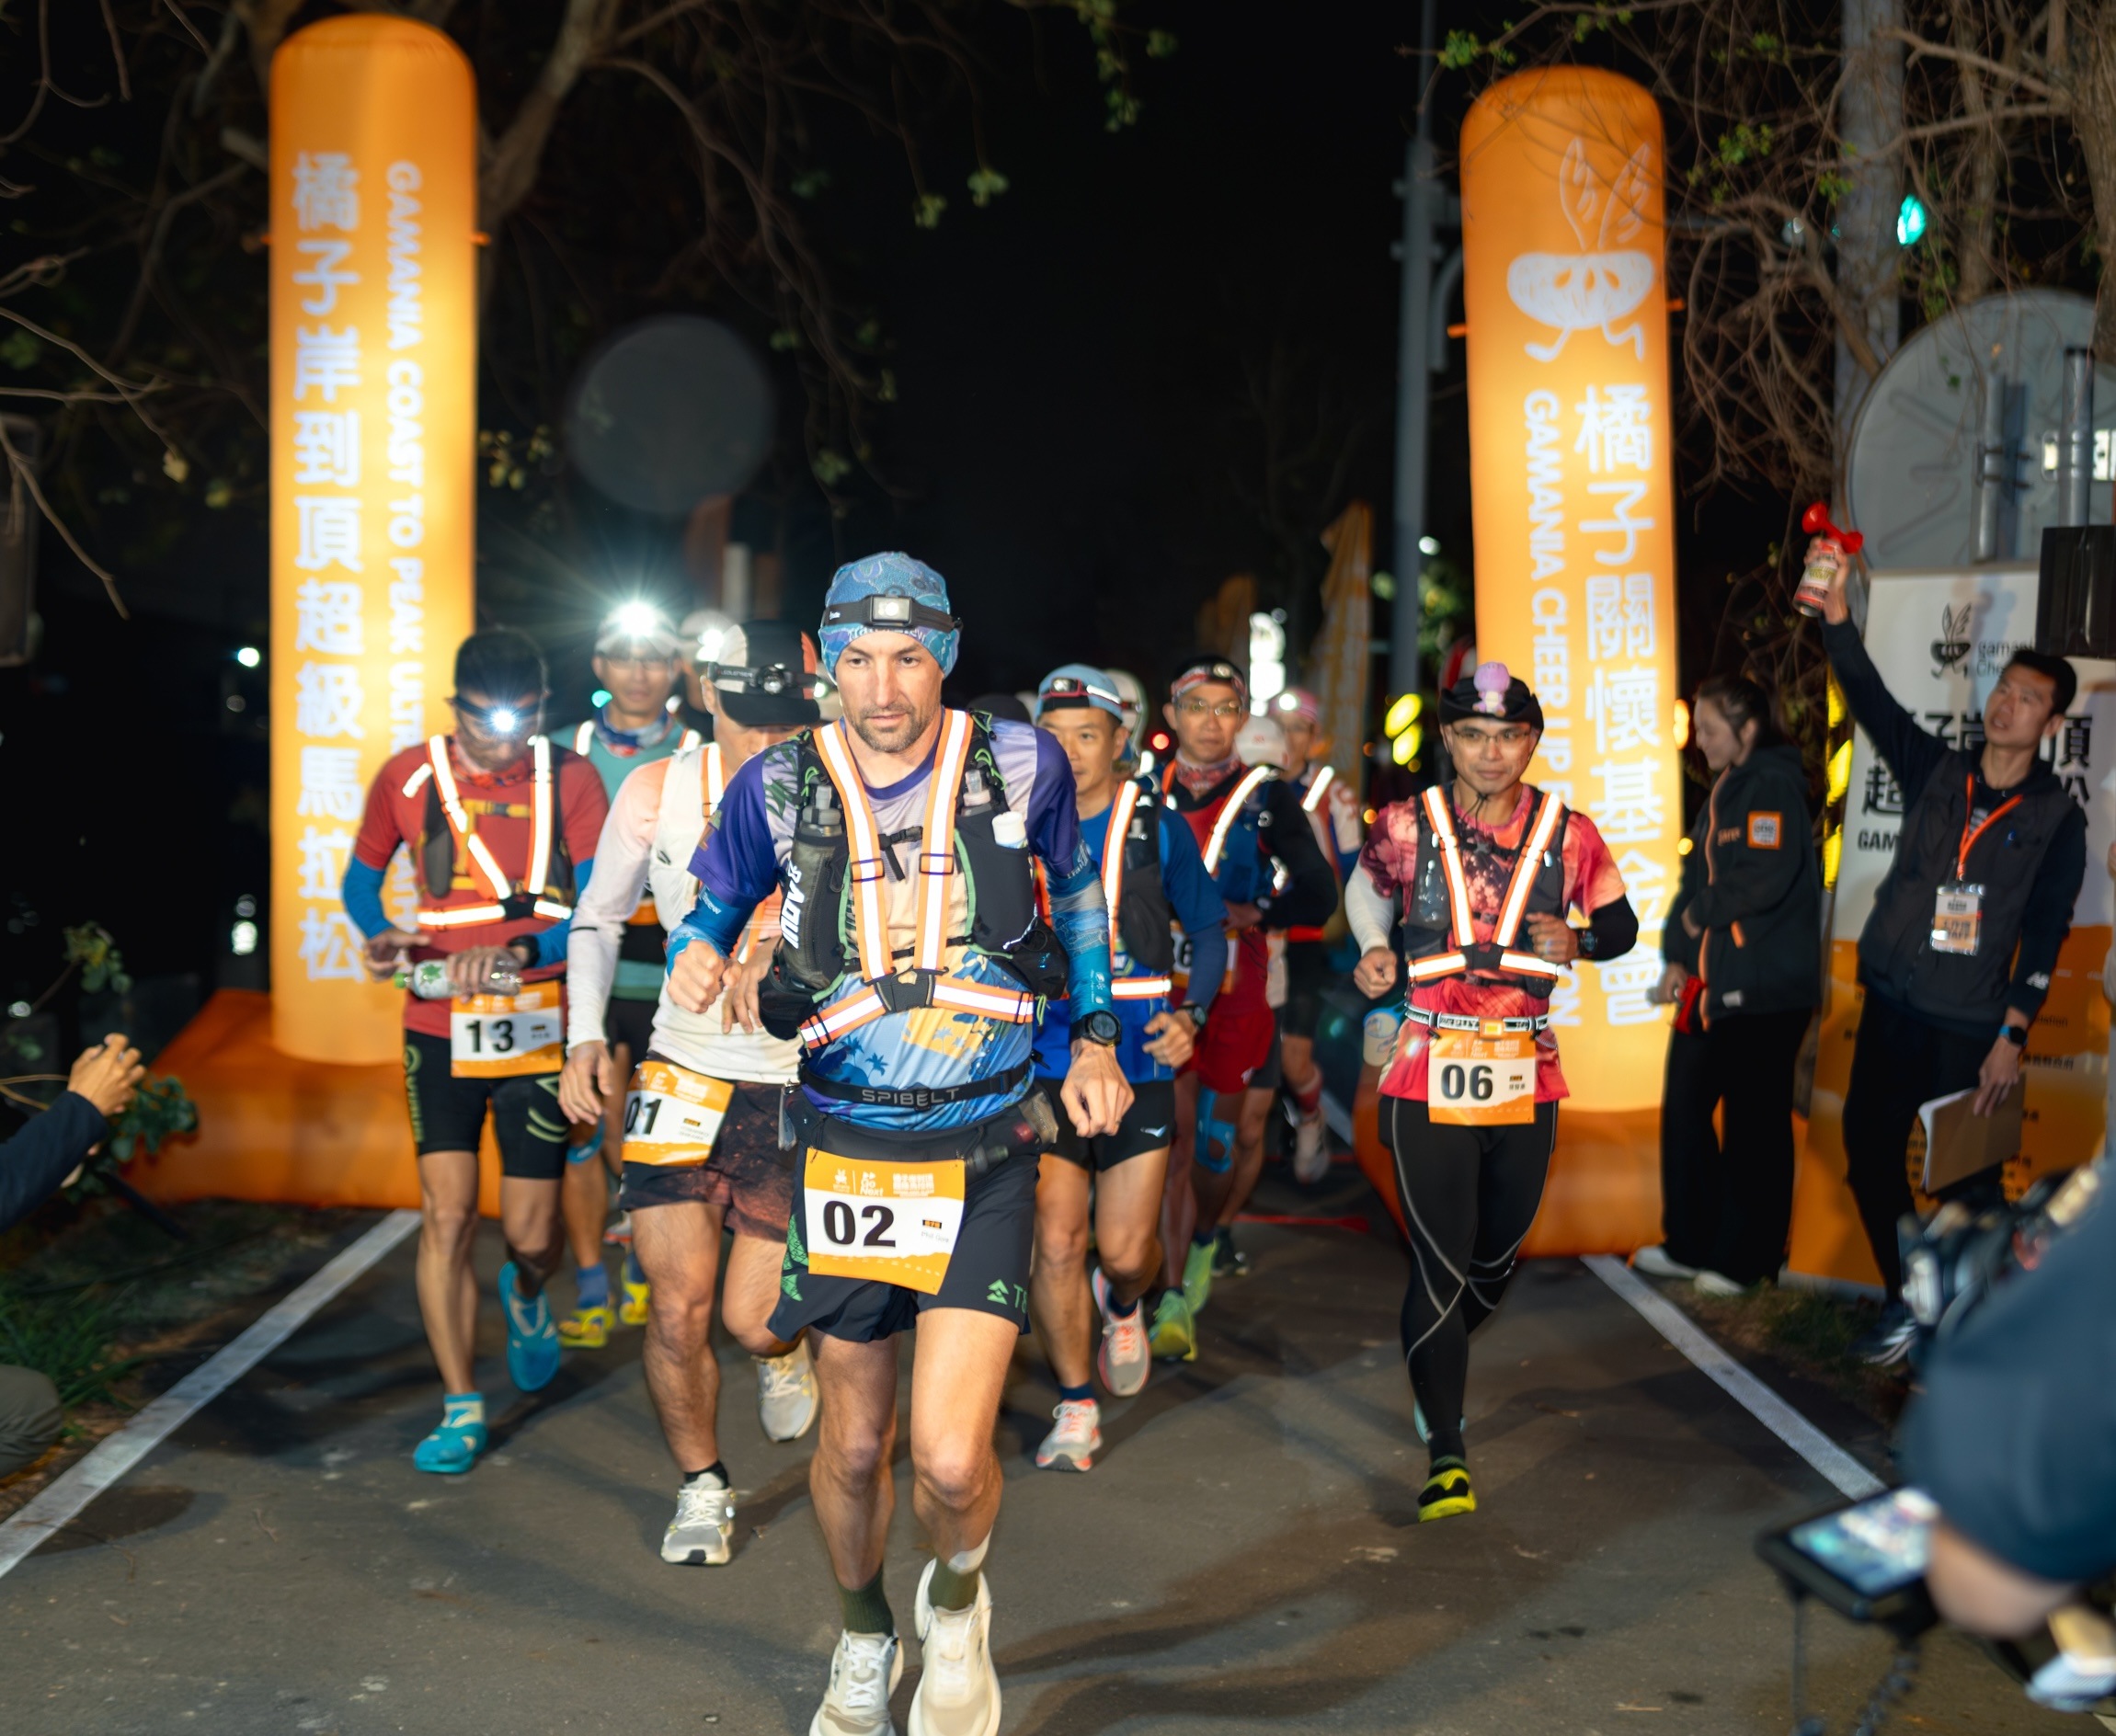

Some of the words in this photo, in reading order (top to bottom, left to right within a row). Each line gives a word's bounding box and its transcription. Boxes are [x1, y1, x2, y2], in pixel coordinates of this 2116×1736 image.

[386, 160, 423, 350] GAMANIA
[386, 360, 424, 487] COAST
[388, 494, 424, 548] TO
[1523, 389, 1565, 581] GAMANIA
[388, 557, 424, 654] PEAK
[1531, 588, 1571, 710] CHEER
[389, 661, 425, 755] ULTR
[1573, 383, 1664, 1027] 橘子關懷基金會
[1537, 718, 1573, 773] UP
[466, 1019, 514, 1054] 13
[624, 1096, 663, 1136] 01
[862, 1087, 960, 1107] SPIBELT
[1441, 1064, 1493, 1101] 06
[823, 1200, 897, 1248] 02
